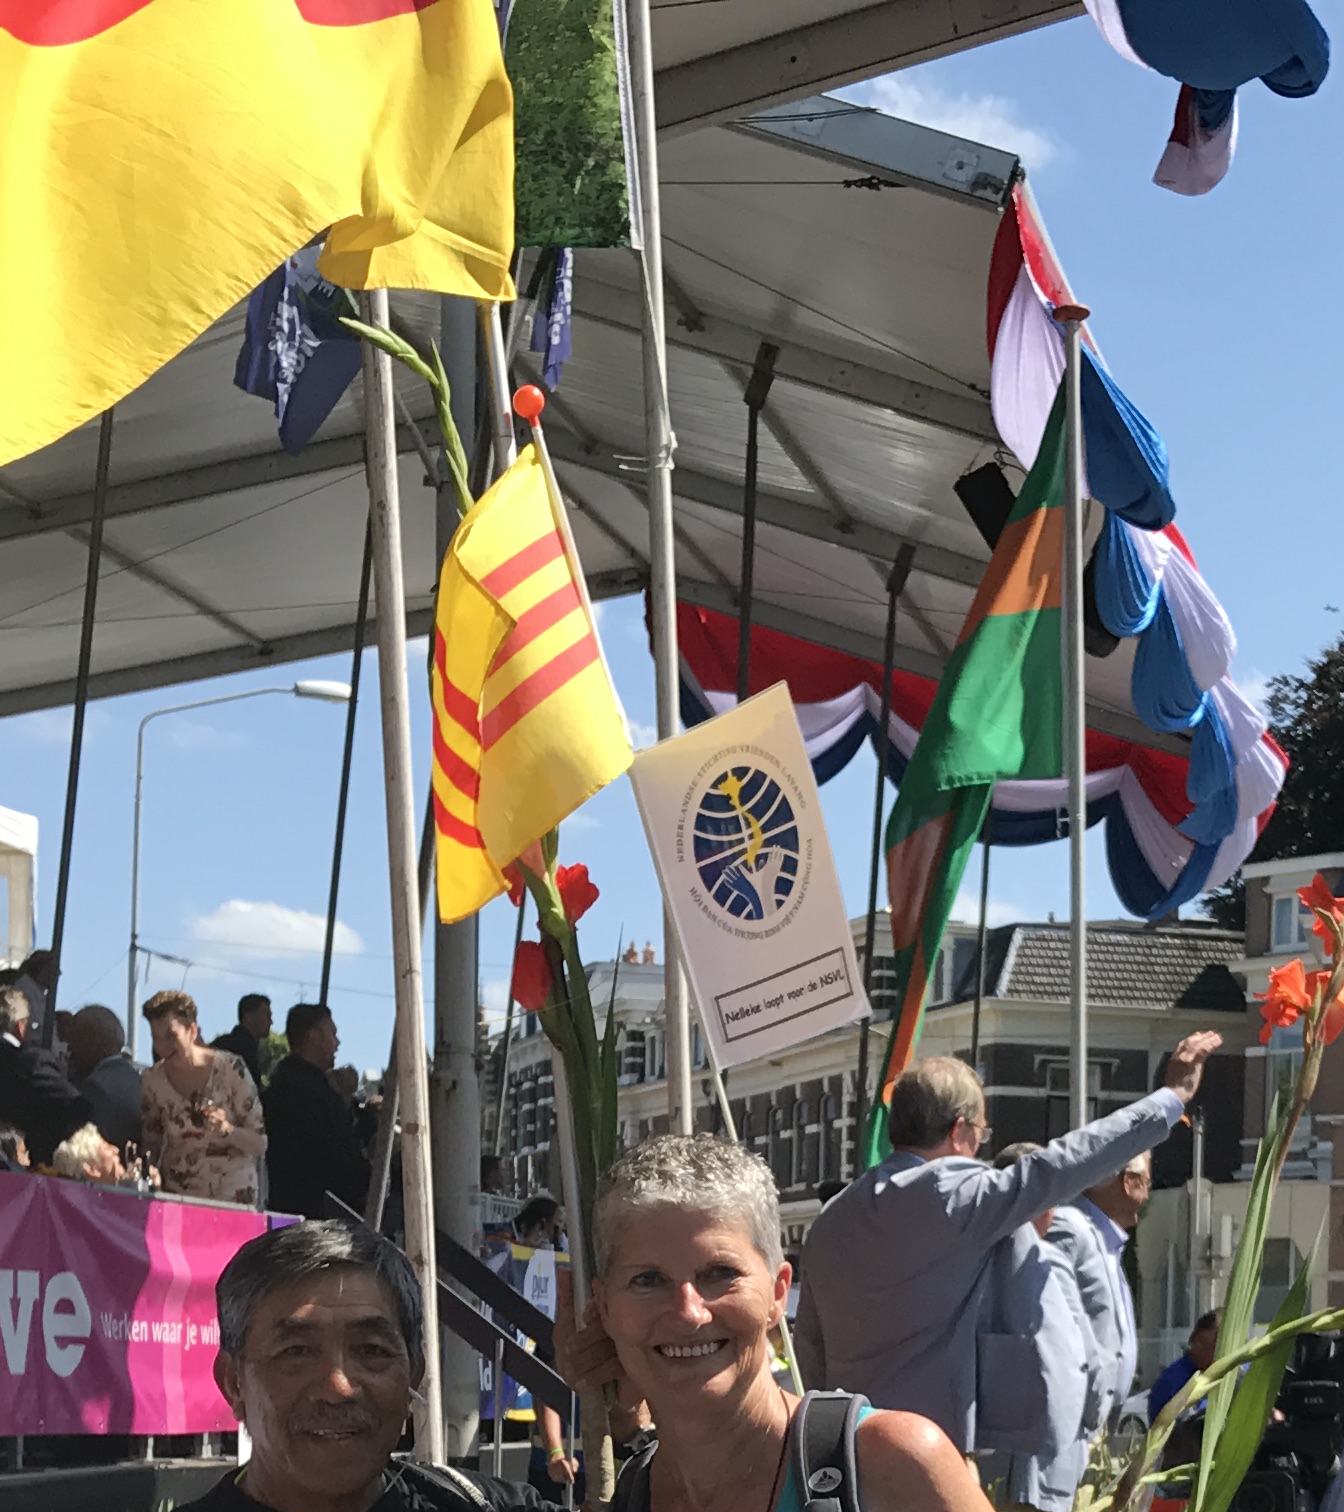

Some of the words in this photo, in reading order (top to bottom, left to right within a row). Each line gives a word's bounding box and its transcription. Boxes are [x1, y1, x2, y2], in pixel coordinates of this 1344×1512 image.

[725, 1003, 762, 1024] Nelleke
[763, 994, 785, 1009] loopt
[787, 987, 804, 1000] voor
[807, 981, 818, 993] de
[100, 1311, 148, 1342] Werken
[152, 1321, 183, 1345] waar
[184, 1317, 198, 1351] je
